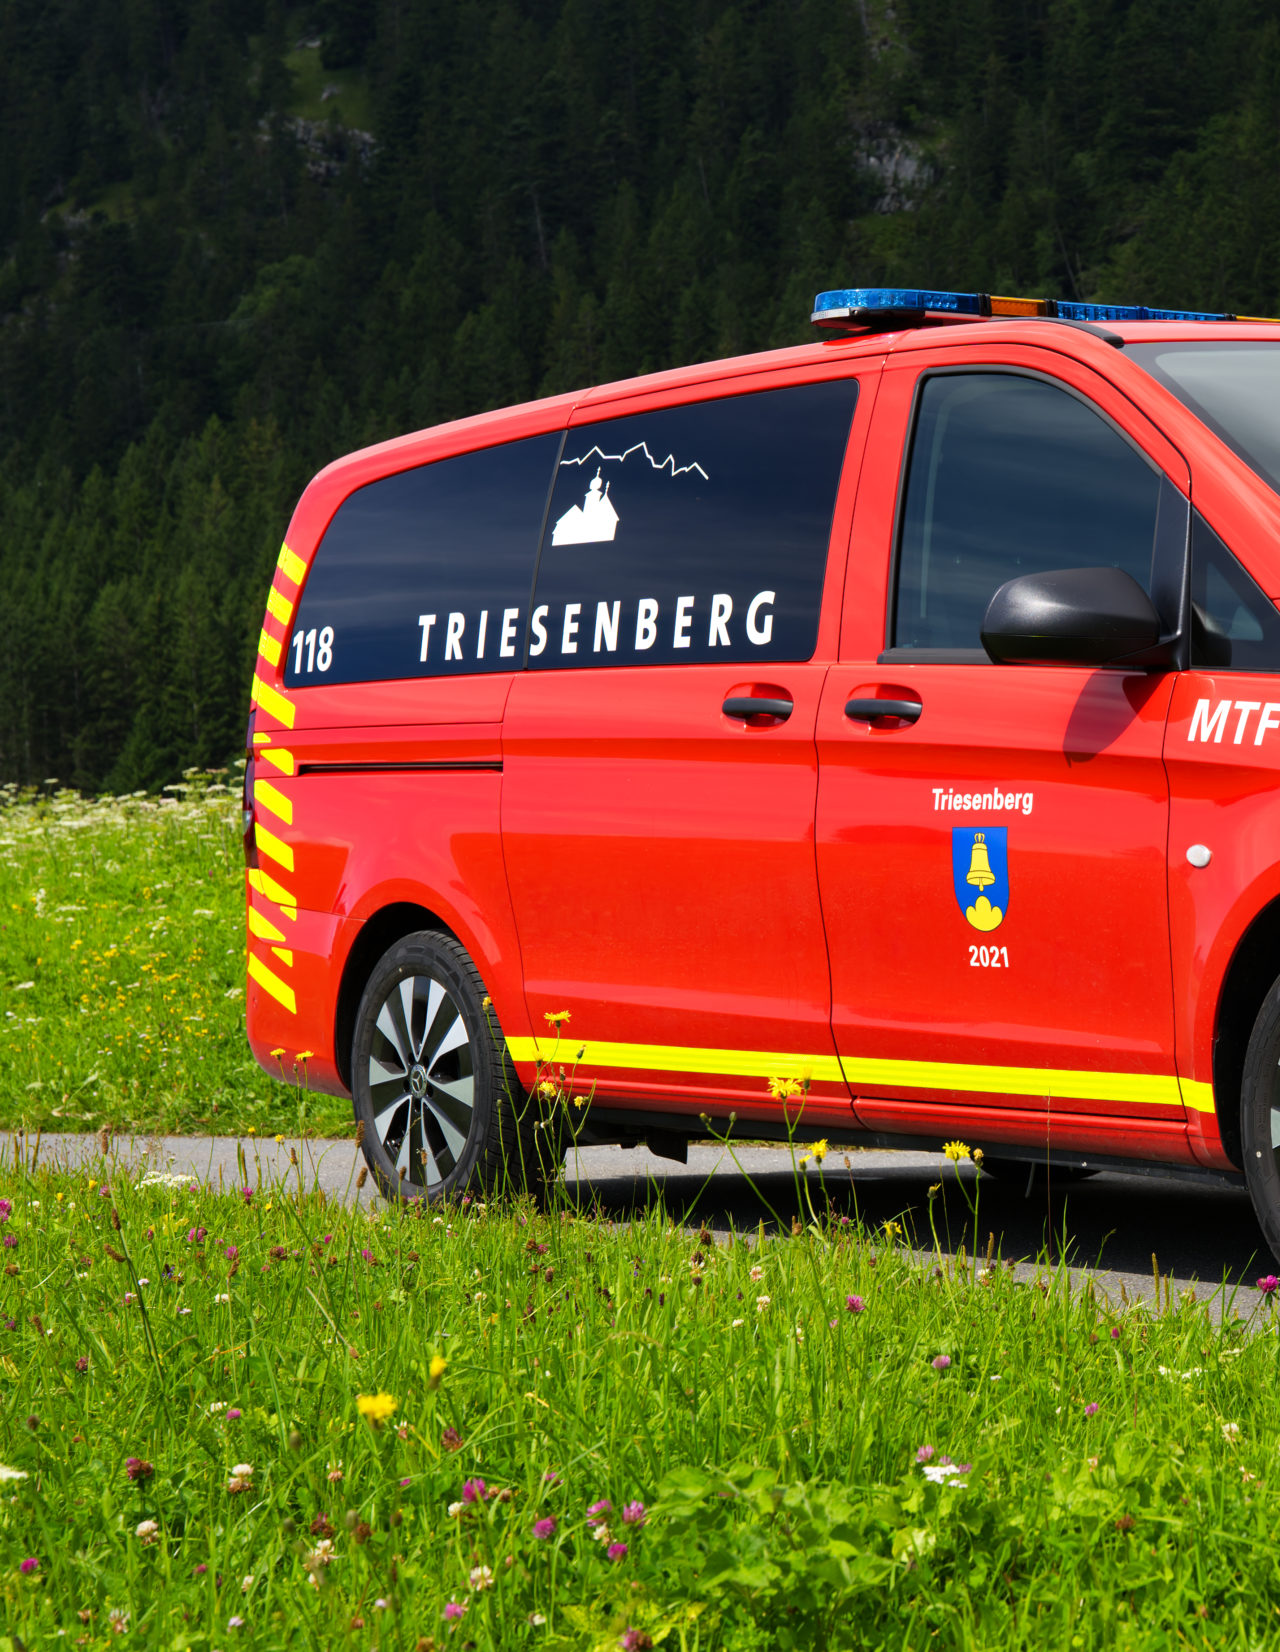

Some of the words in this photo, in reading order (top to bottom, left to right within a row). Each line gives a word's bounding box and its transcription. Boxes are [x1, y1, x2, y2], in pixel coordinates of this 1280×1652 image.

[418, 590, 776, 662] TRIESENBERG
[292, 625, 334, 674] 118
[932, 787, 1034, 816] Triesenberg
[968, 945, 1009, 968] 2021
